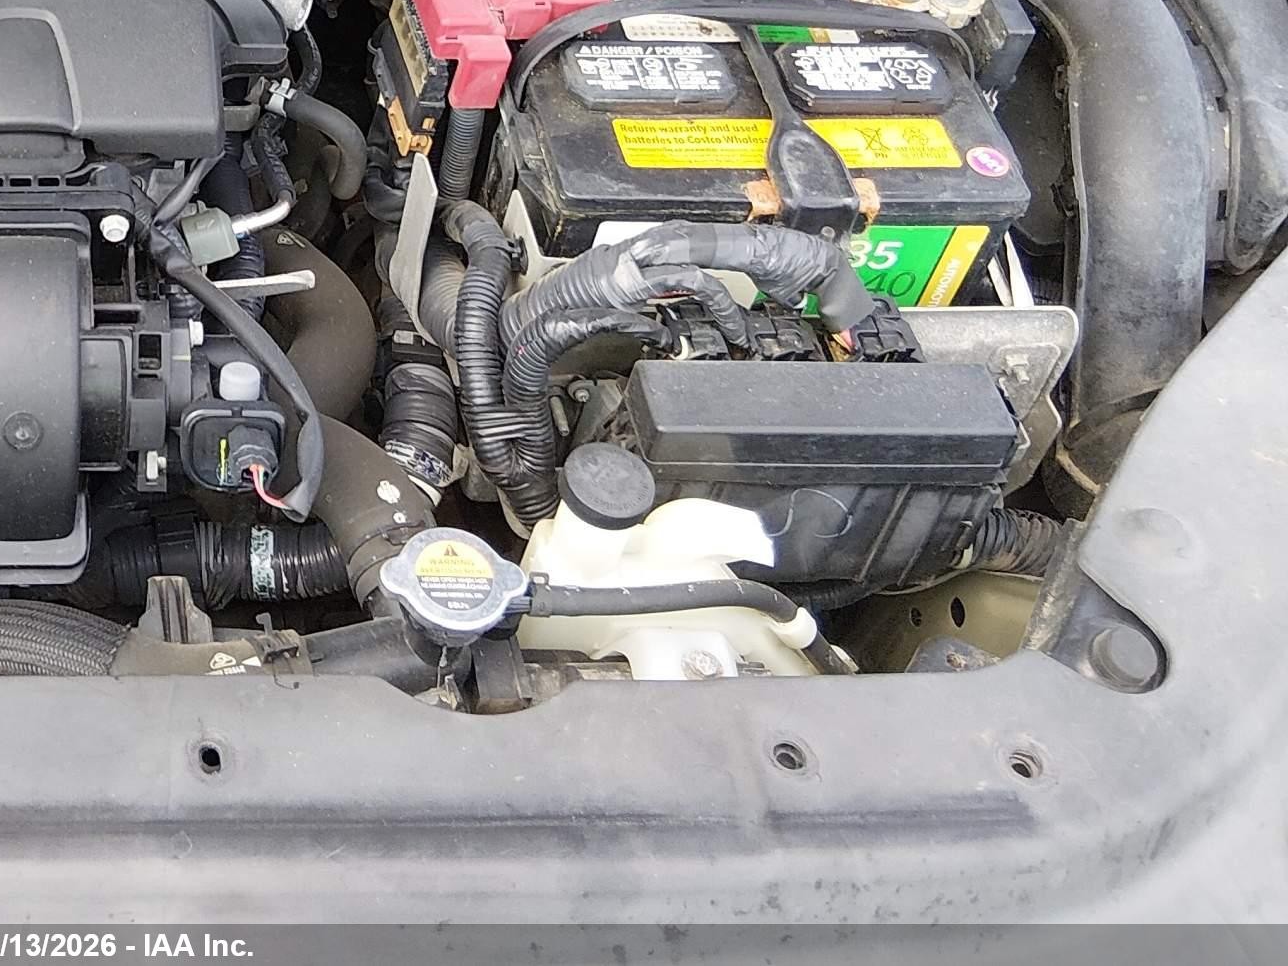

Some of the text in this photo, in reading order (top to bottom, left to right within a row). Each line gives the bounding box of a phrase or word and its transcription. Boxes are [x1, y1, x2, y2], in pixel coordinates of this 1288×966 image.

[591, 45, 644, 55] DANGER
[655, 46, 703, 55] POISON
[620, 123, 758, 135] Return warranty and used
[624, 135, 768, 145] batteries to Costco Wholesa
[863, 272, 916, 297] 40
[927, 259, 959, 308] AUTOMOT
